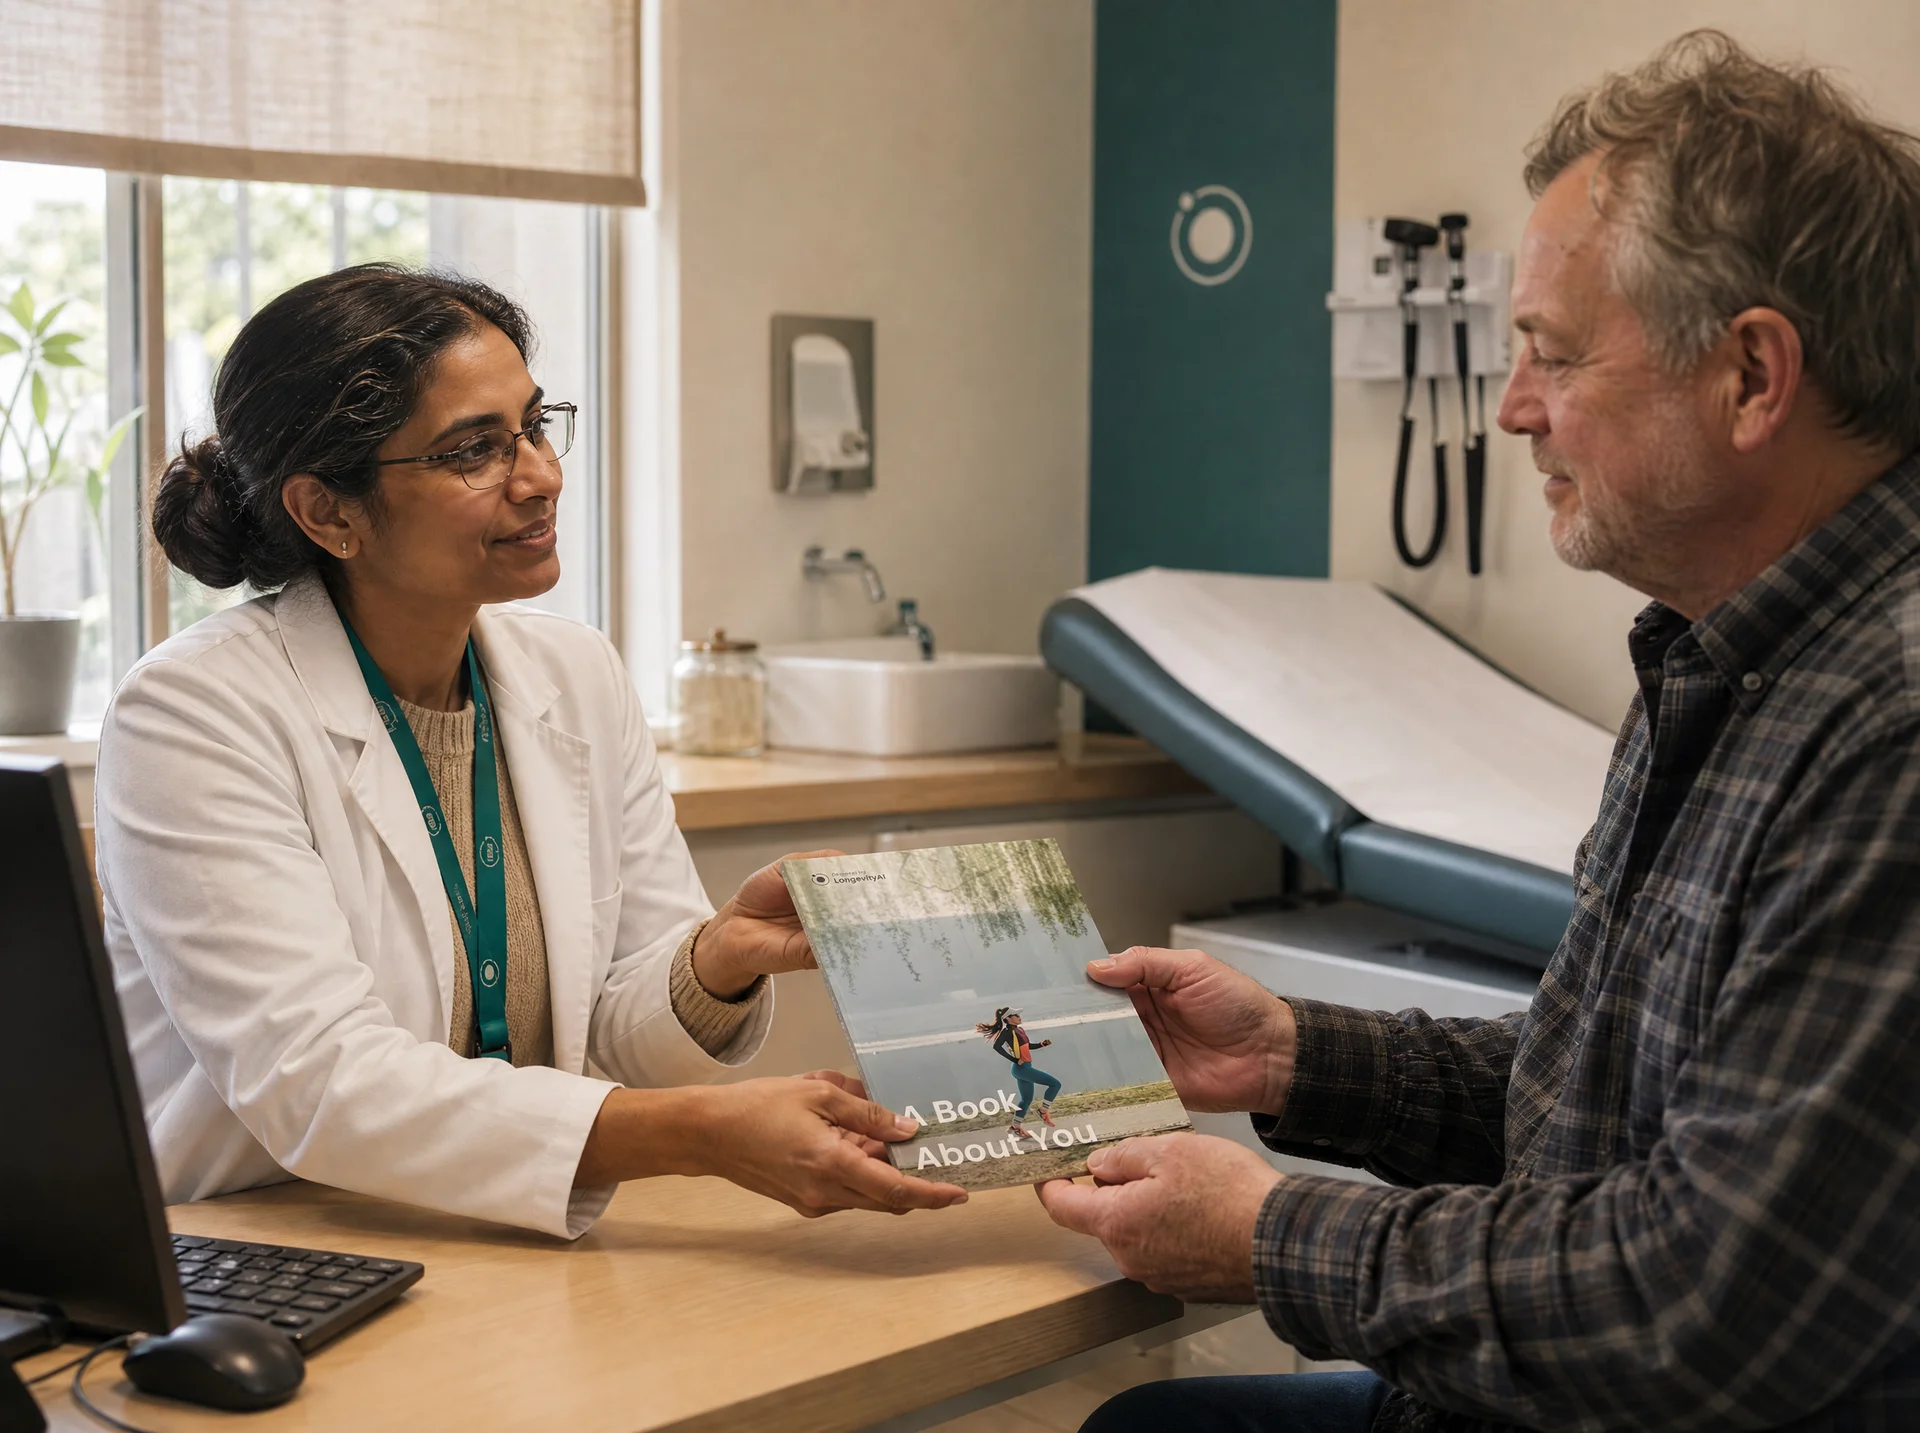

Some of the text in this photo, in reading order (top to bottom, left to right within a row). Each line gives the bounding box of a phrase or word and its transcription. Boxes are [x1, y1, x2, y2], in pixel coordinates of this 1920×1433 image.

[834, 874, 886, 884] LongevityAI
[904, 1089, 1023, 1127] A Book
[917, 1124, 1099, 1171] About You
